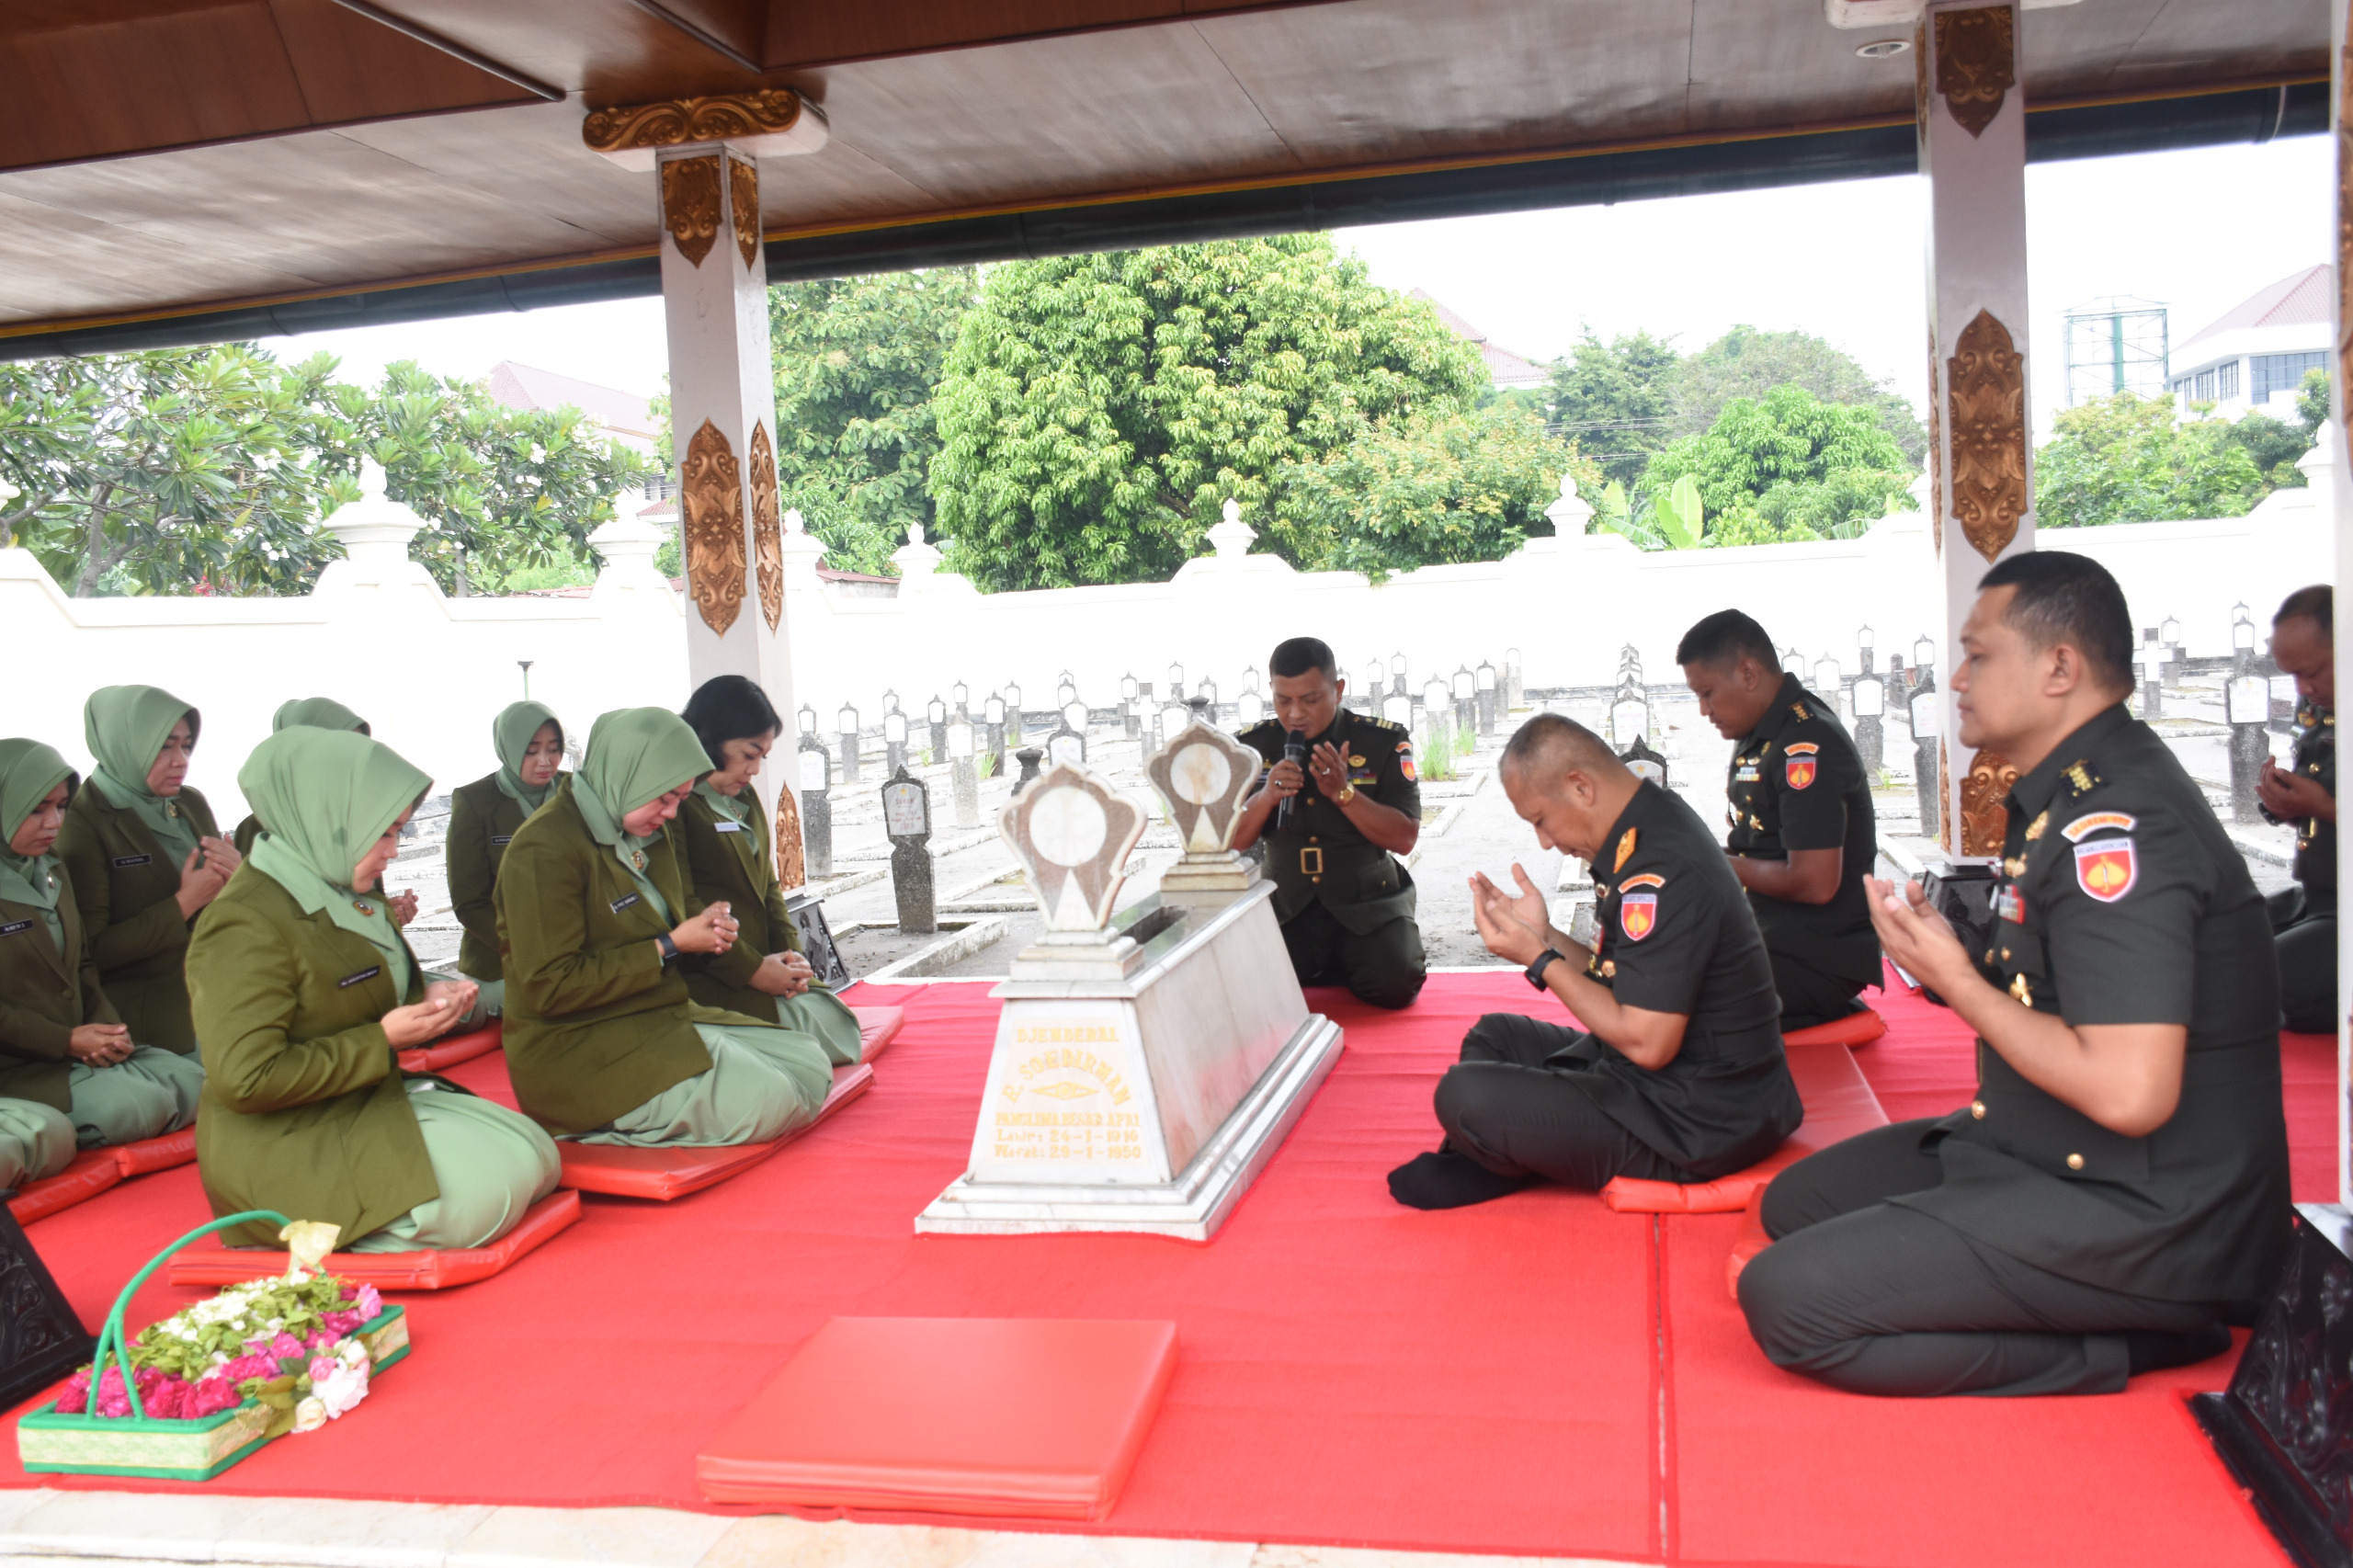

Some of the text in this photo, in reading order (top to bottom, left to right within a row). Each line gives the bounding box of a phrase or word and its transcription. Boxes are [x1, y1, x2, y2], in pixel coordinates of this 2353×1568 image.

[1017, 1027, 1120, 1043] DJENDERAL
[1001, 1048, 1132, 1107] R. SOEDIRMAN
[995, 1111, 1140, 1127] PANGLIMA BESAR APRI
